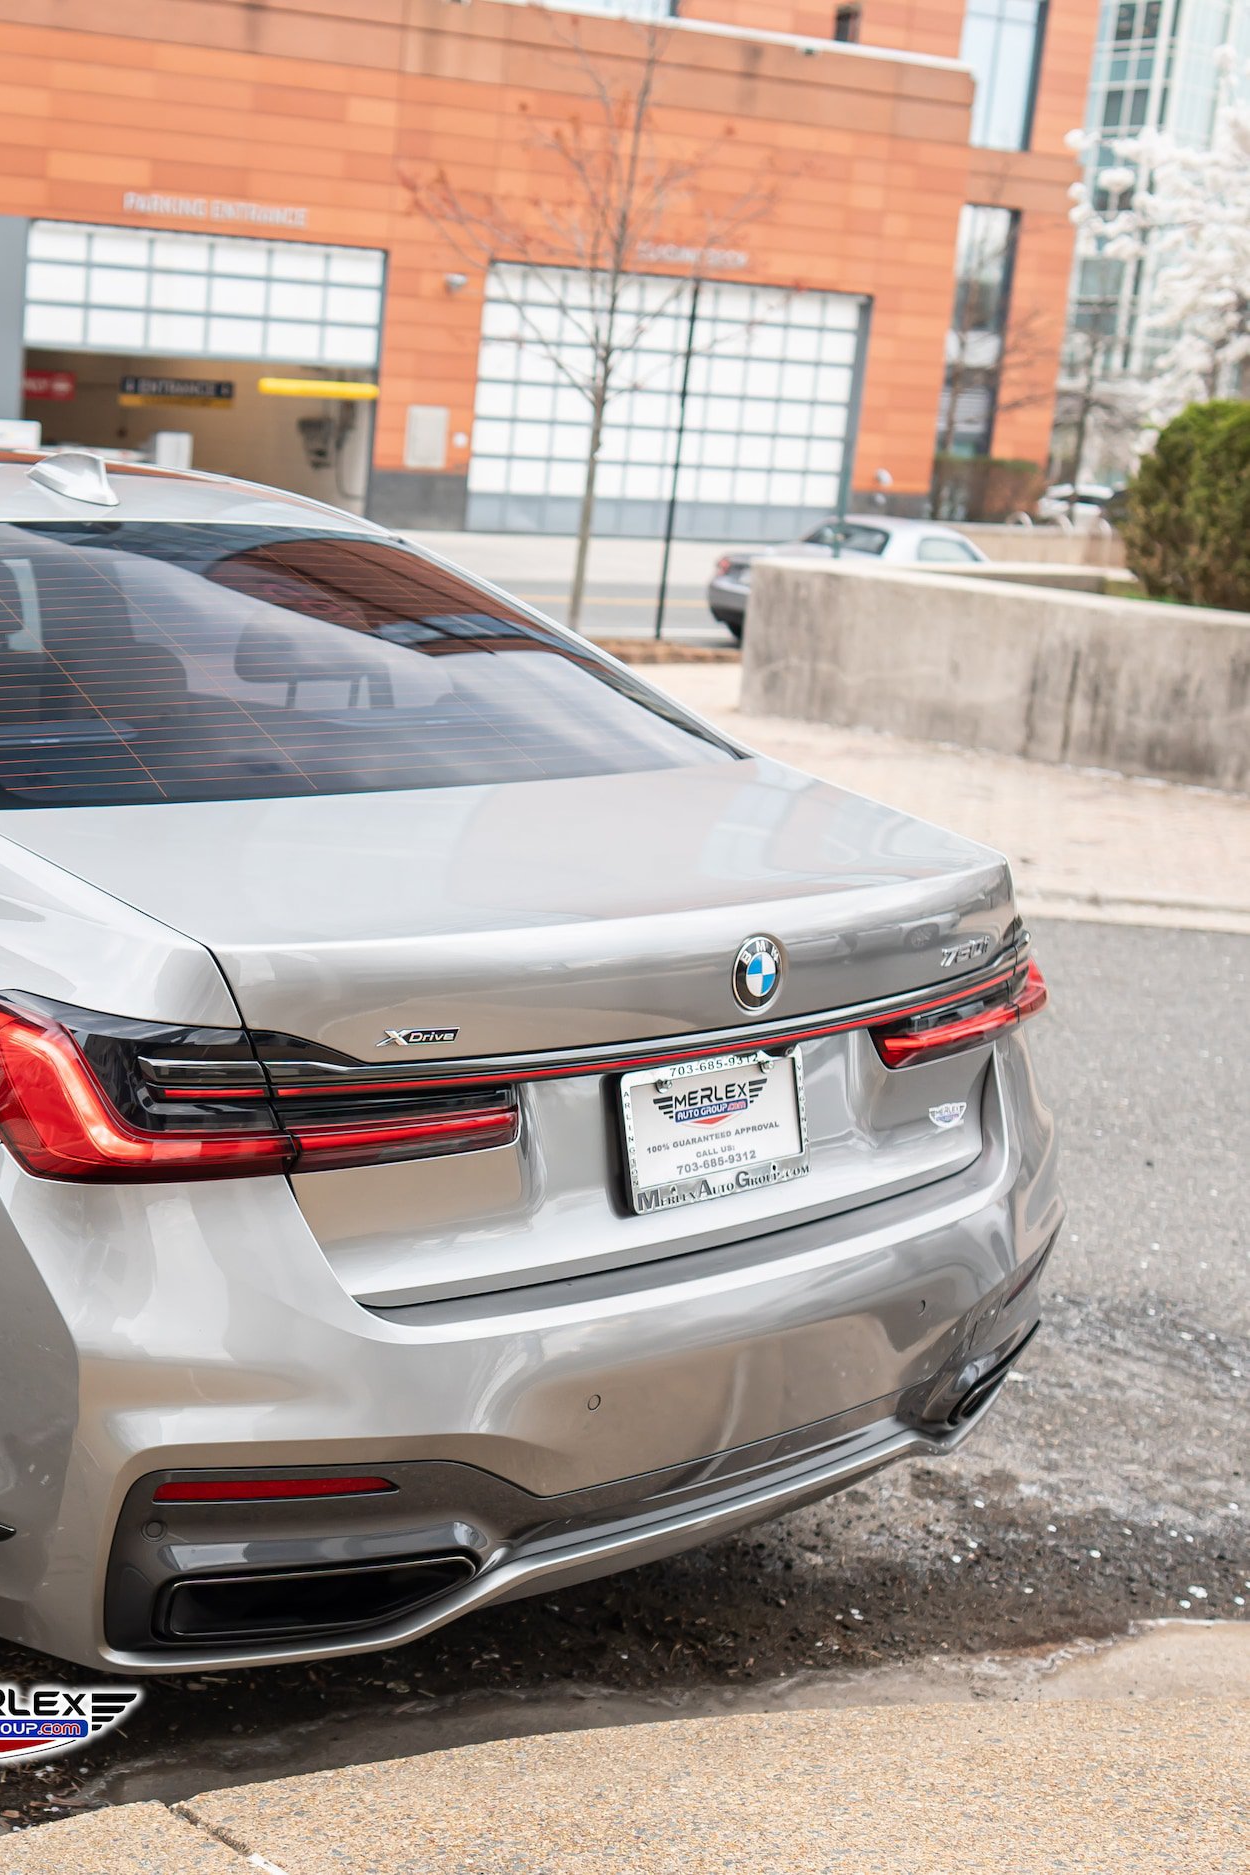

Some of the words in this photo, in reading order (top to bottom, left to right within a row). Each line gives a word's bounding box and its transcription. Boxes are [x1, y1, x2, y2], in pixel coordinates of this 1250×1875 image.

[123, 191, 206, 219] PARKING
[210, 199, 308, 229] ENTRANCE
[740, 940, 779, 965] BMW
[670, 1053, 759, 1077] 703-685-9312
[674, 1082, 747, 1109] MERLEX
[677, 1108, 700, 1121] AUTO
[647, 1144, 670, 1155] 100%
[672, 1131, 732, 1149] GUARANTEED
[734, 1121, 780, 1137] APPROVAL
[676, 1150, 757, 1175] 703-685-9312
[696, 1147, 718, 1158] CALL
[720, 1145, 736, 1154] US:
